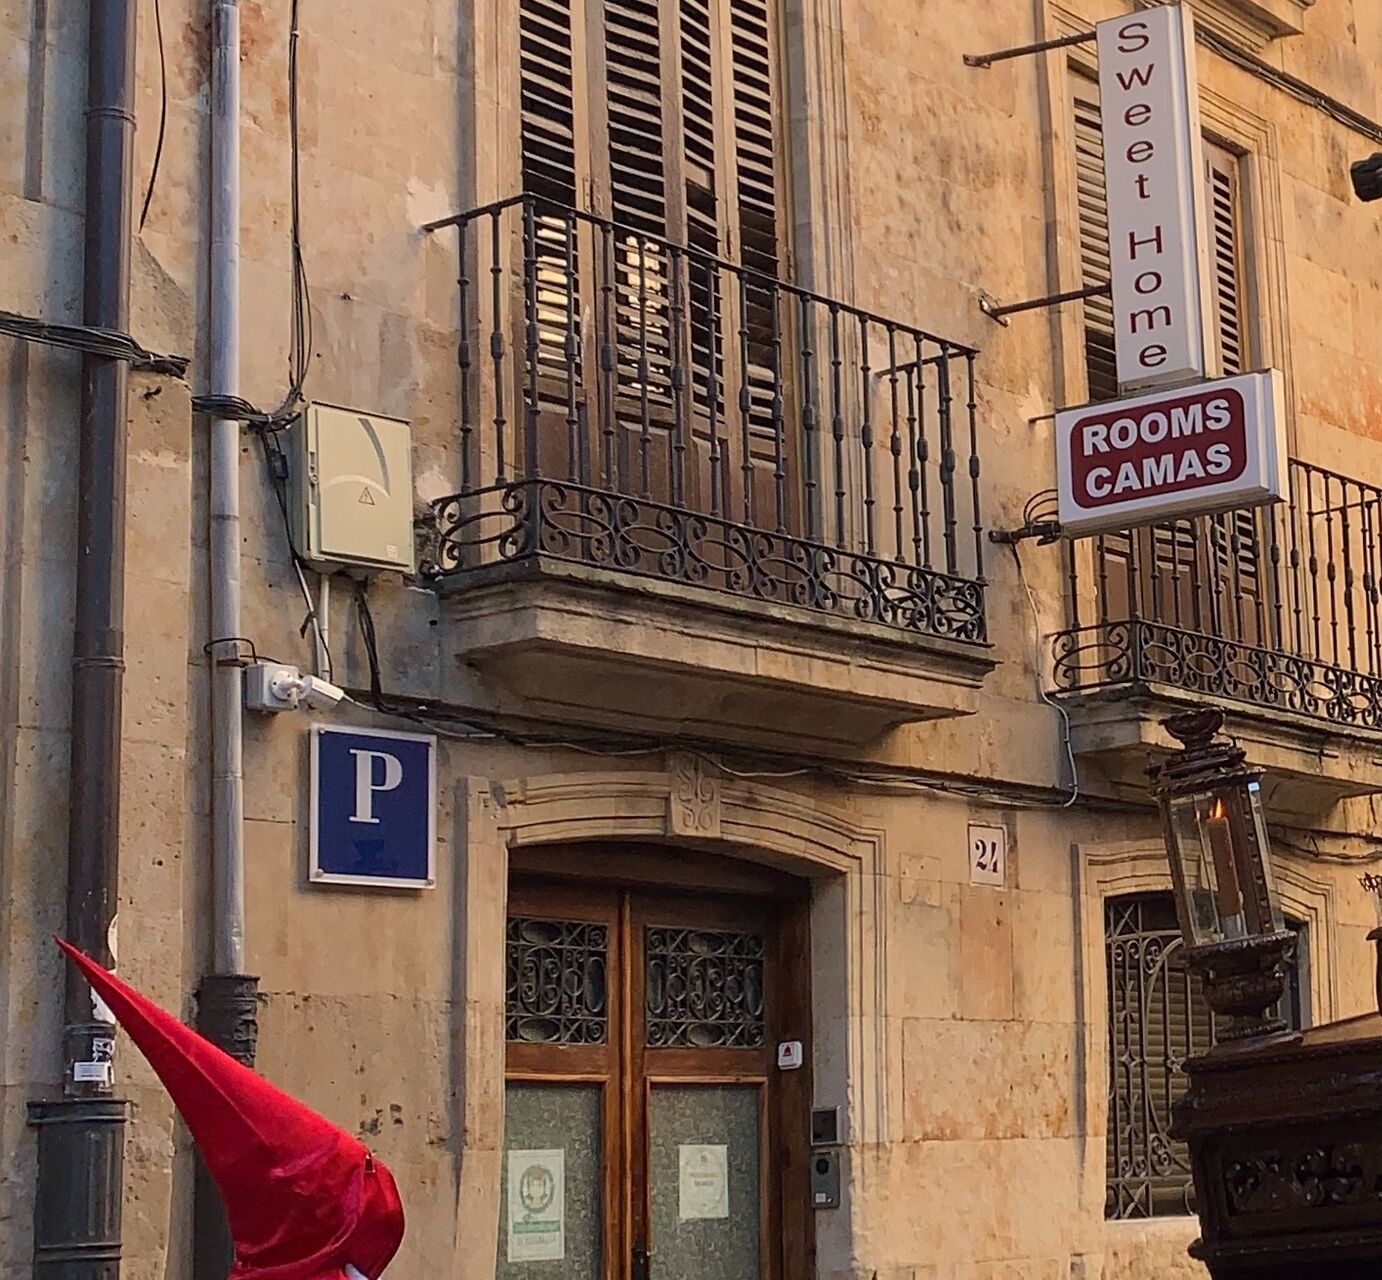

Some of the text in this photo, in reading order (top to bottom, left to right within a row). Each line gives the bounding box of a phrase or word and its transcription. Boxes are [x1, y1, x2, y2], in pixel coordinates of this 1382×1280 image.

[1115, 22, 1172, 368] Sweet Home
[1082, 397, 1231, 456] ROOMS
[1085, 442, 1232, 498] CAMAS
[349, 748, 403, 824] P
